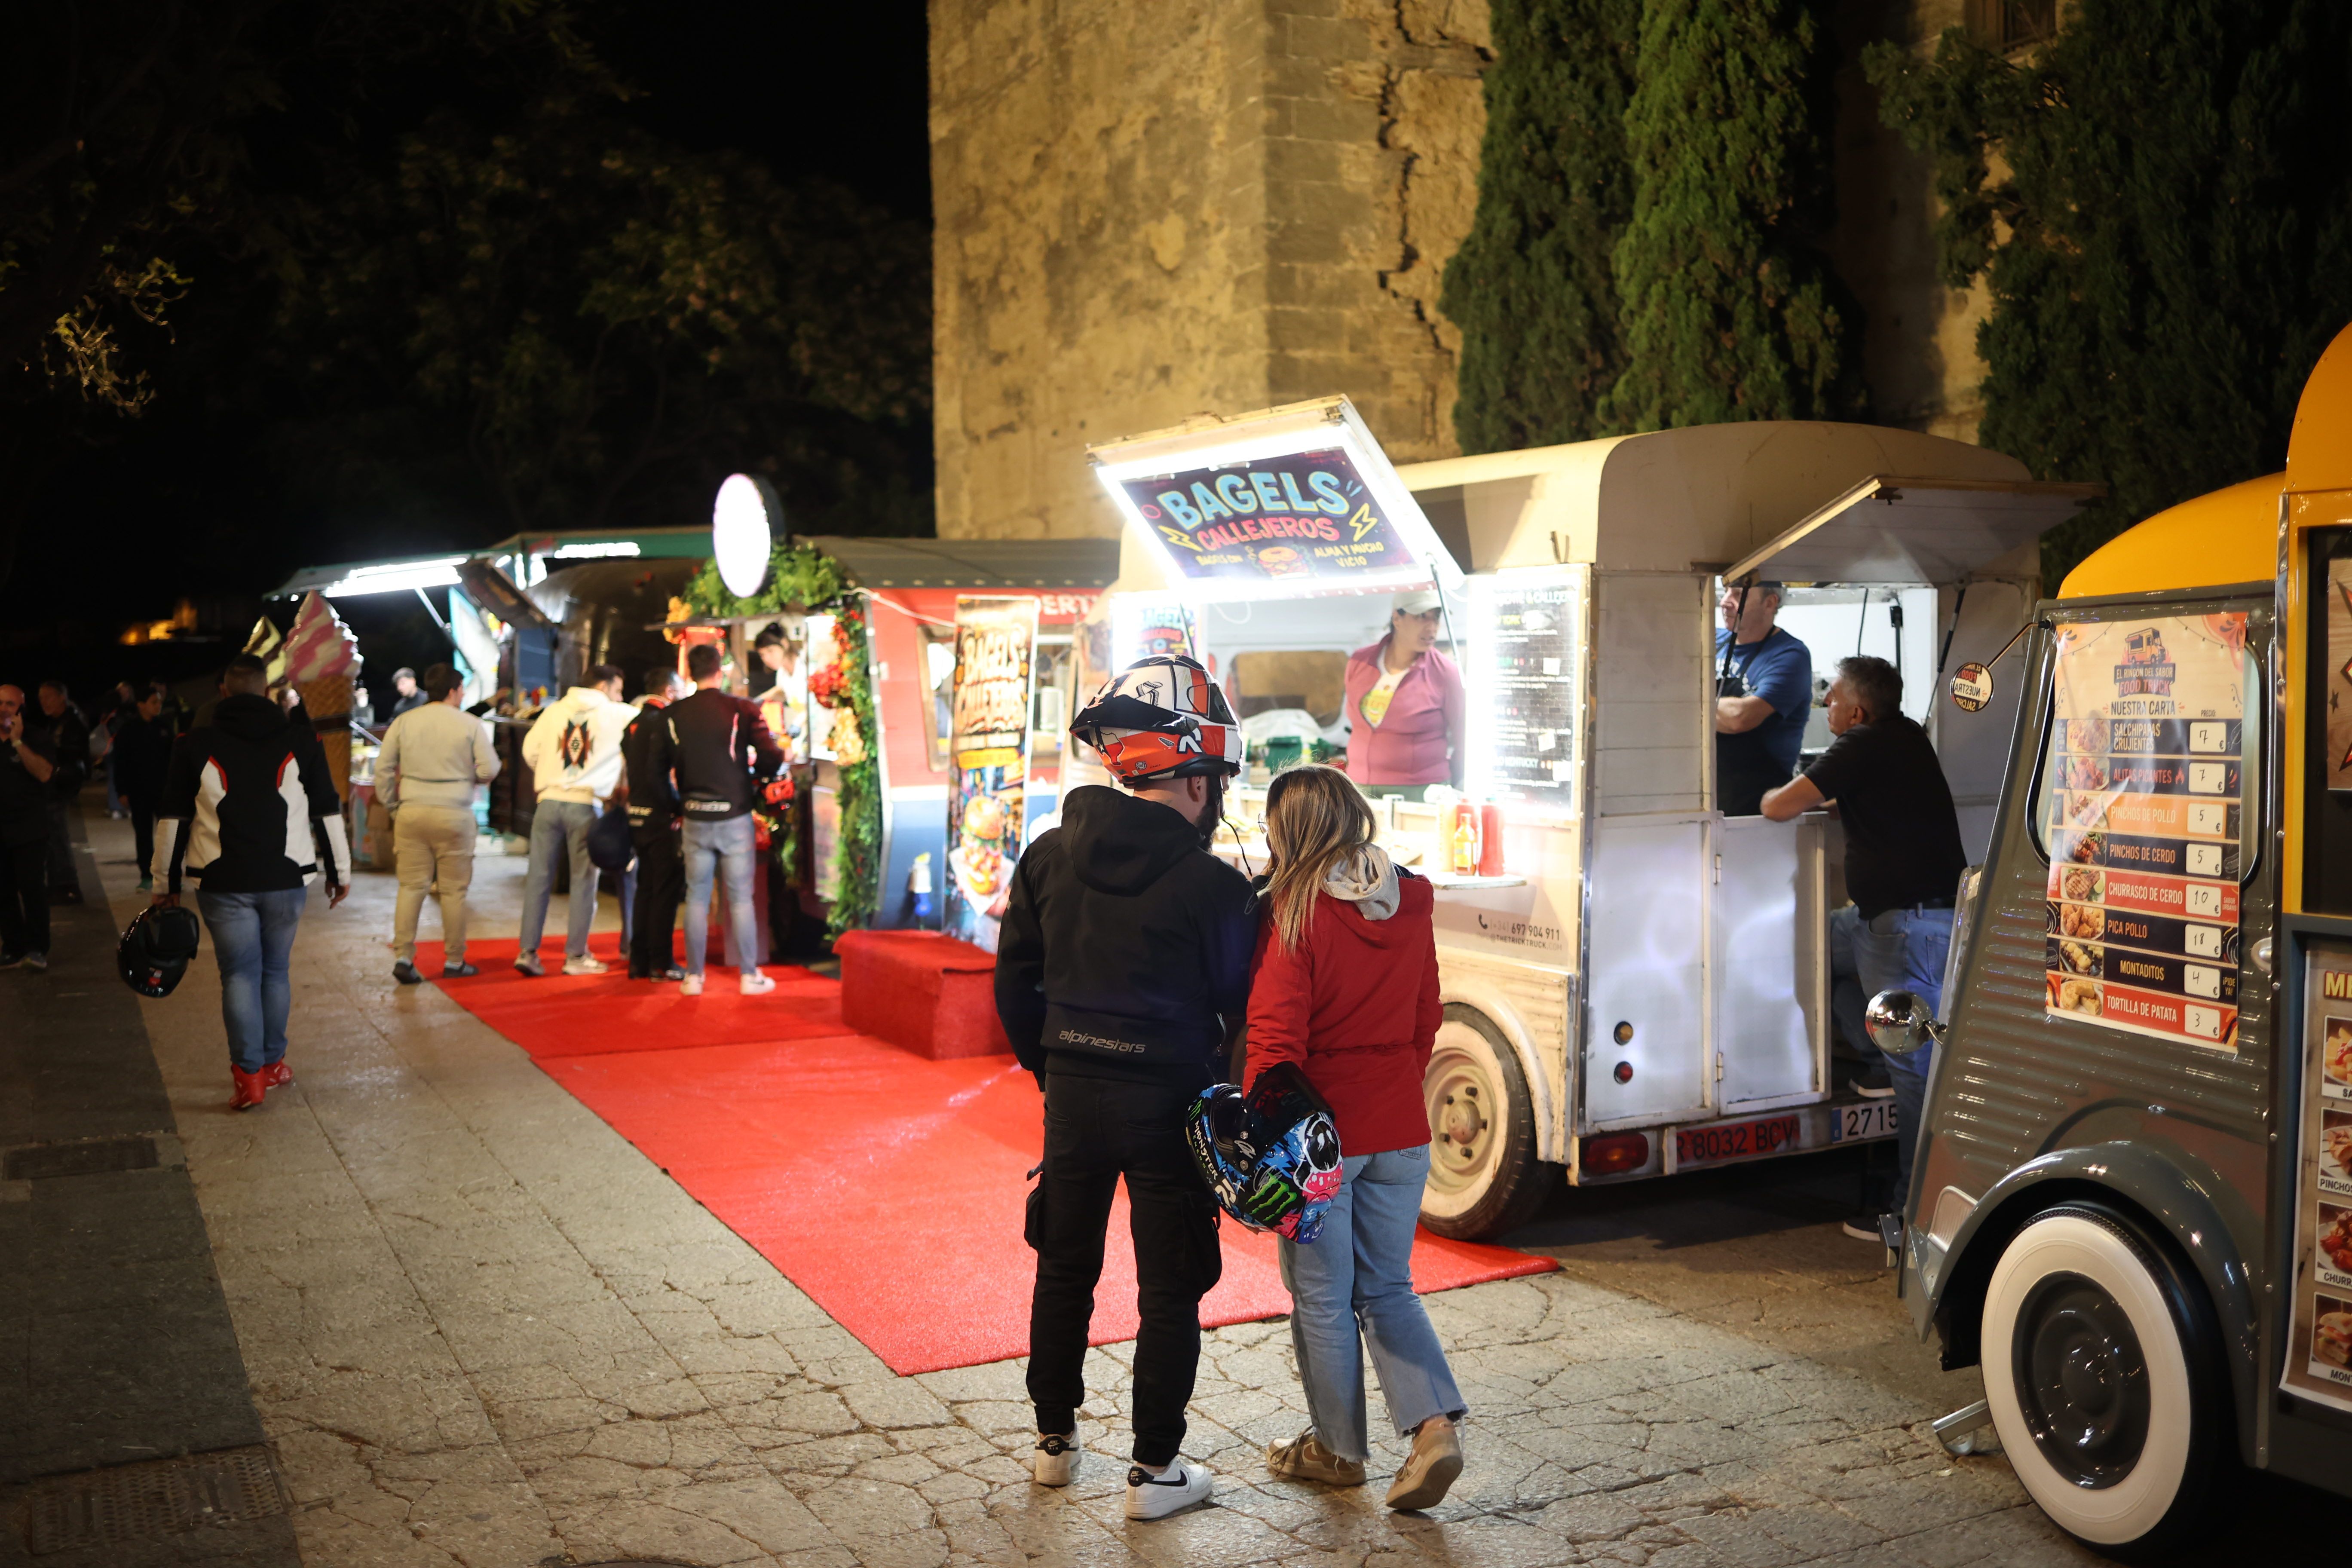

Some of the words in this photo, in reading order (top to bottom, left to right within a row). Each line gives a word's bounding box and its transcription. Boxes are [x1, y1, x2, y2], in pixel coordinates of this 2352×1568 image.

[1157, 471, 1350, 531] BAGELS
[1197, 517, 1340, 551] CALLEJEROS
[1314, 546, 1341, 559] ALMA
[1350, 541, 1384, 554] MUCHO
[1335, 556, 1368, 567] VICIO
[2116, 669, 2122, 679] EL
[2124, 667, 2143, 678] RINCÓN
[2144, 668, 2154, 677] DEL
[2156, 667, 2174, 678] SABOR
[2119, 680, 2141, 695] FOOD
[2144, 679, 2170, 695] TRUCK
[2111, 701, 2147, 716] NUESTRA
[2149, 700, 2175, 716] CARTA
[2114, 723, 2161, 737] SALCHIPAPAS
[2199, 729, 2208, 744] 7
[2114, 737, 2155, 751] CRUJIENTES
[2113, 767, 2137, 782] ALITAS
[2138, 769, 2173, 784] PICANTES
[2199, 769, 2206, 781] 7
[2111, 805, 2141, 821] PINCHOS
[2142, 807, 2151, 821] DE
[2152, 808, 2176, 823] POLLO
[2199, 809, 2205, 821] 5
[2110, 844, 2140, 860] PINCHOS
[2141, 847, 2151, 861] DE
[2152, 848, 2176, 864] CERDO
[2198, 850, 2204, 864] 5
[2108, 882, 2148, 900] CHURRASCO
[2149, 887, 2158, 901] DE
[2159, 888, 2183, 905] CERDO
[2194, 890, 2208, 906] 10
[1512, 923, 1526, 936] 697
[1528, 925, 1543, 938] 904
[1546, 928, 1559, 941] 911
[2107, 919, 2123, 935] PICA
[2125, 922, 2148, 939] POLLO
[2194, 933, 2205, 946] 18
[2120, 960, 2165, 981] MONTADITOS
[2193, 971, 2199, 984] 4
[2107, 995, 2138, 1015] TORTILLA
[2140, 1002, 2149, 1017] DE
[2151, 1004, 2177, 1023] PATATA
[2195, 1013, 2200, 1027] 3
[1059, 1030, 1146, 1053] alpinestars
[1847, 1105, 1899, 1136] 2715
[1693, 1127, 1748, 1160] 8032
[1755, 1119, 1796, 1152] BCV
[2320, 1178, 2352, 1193] PINCHO
[2324, 1272, 2352, 1286] CHURR
[2331, 1369, 2352, 1384] MON
